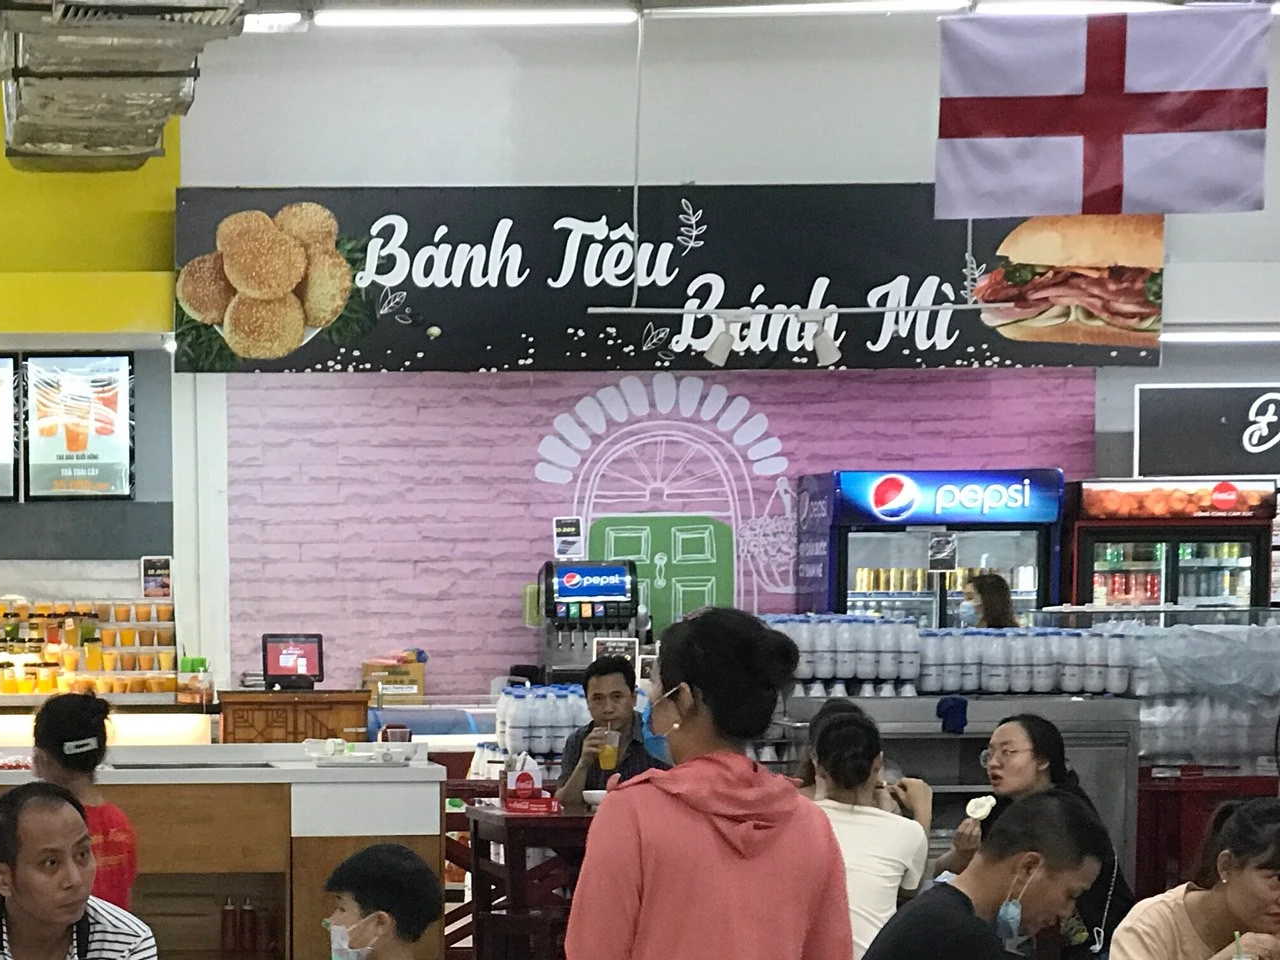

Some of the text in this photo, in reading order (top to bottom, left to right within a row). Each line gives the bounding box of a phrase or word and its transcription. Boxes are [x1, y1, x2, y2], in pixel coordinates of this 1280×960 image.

[355, 214, 679, 288] Bánh Tiêu
[671, 273, 960, 352] Bánh Mì
[934, 478, 1031, 514] pepsi
[583, 574, 620, 587] pepsi
